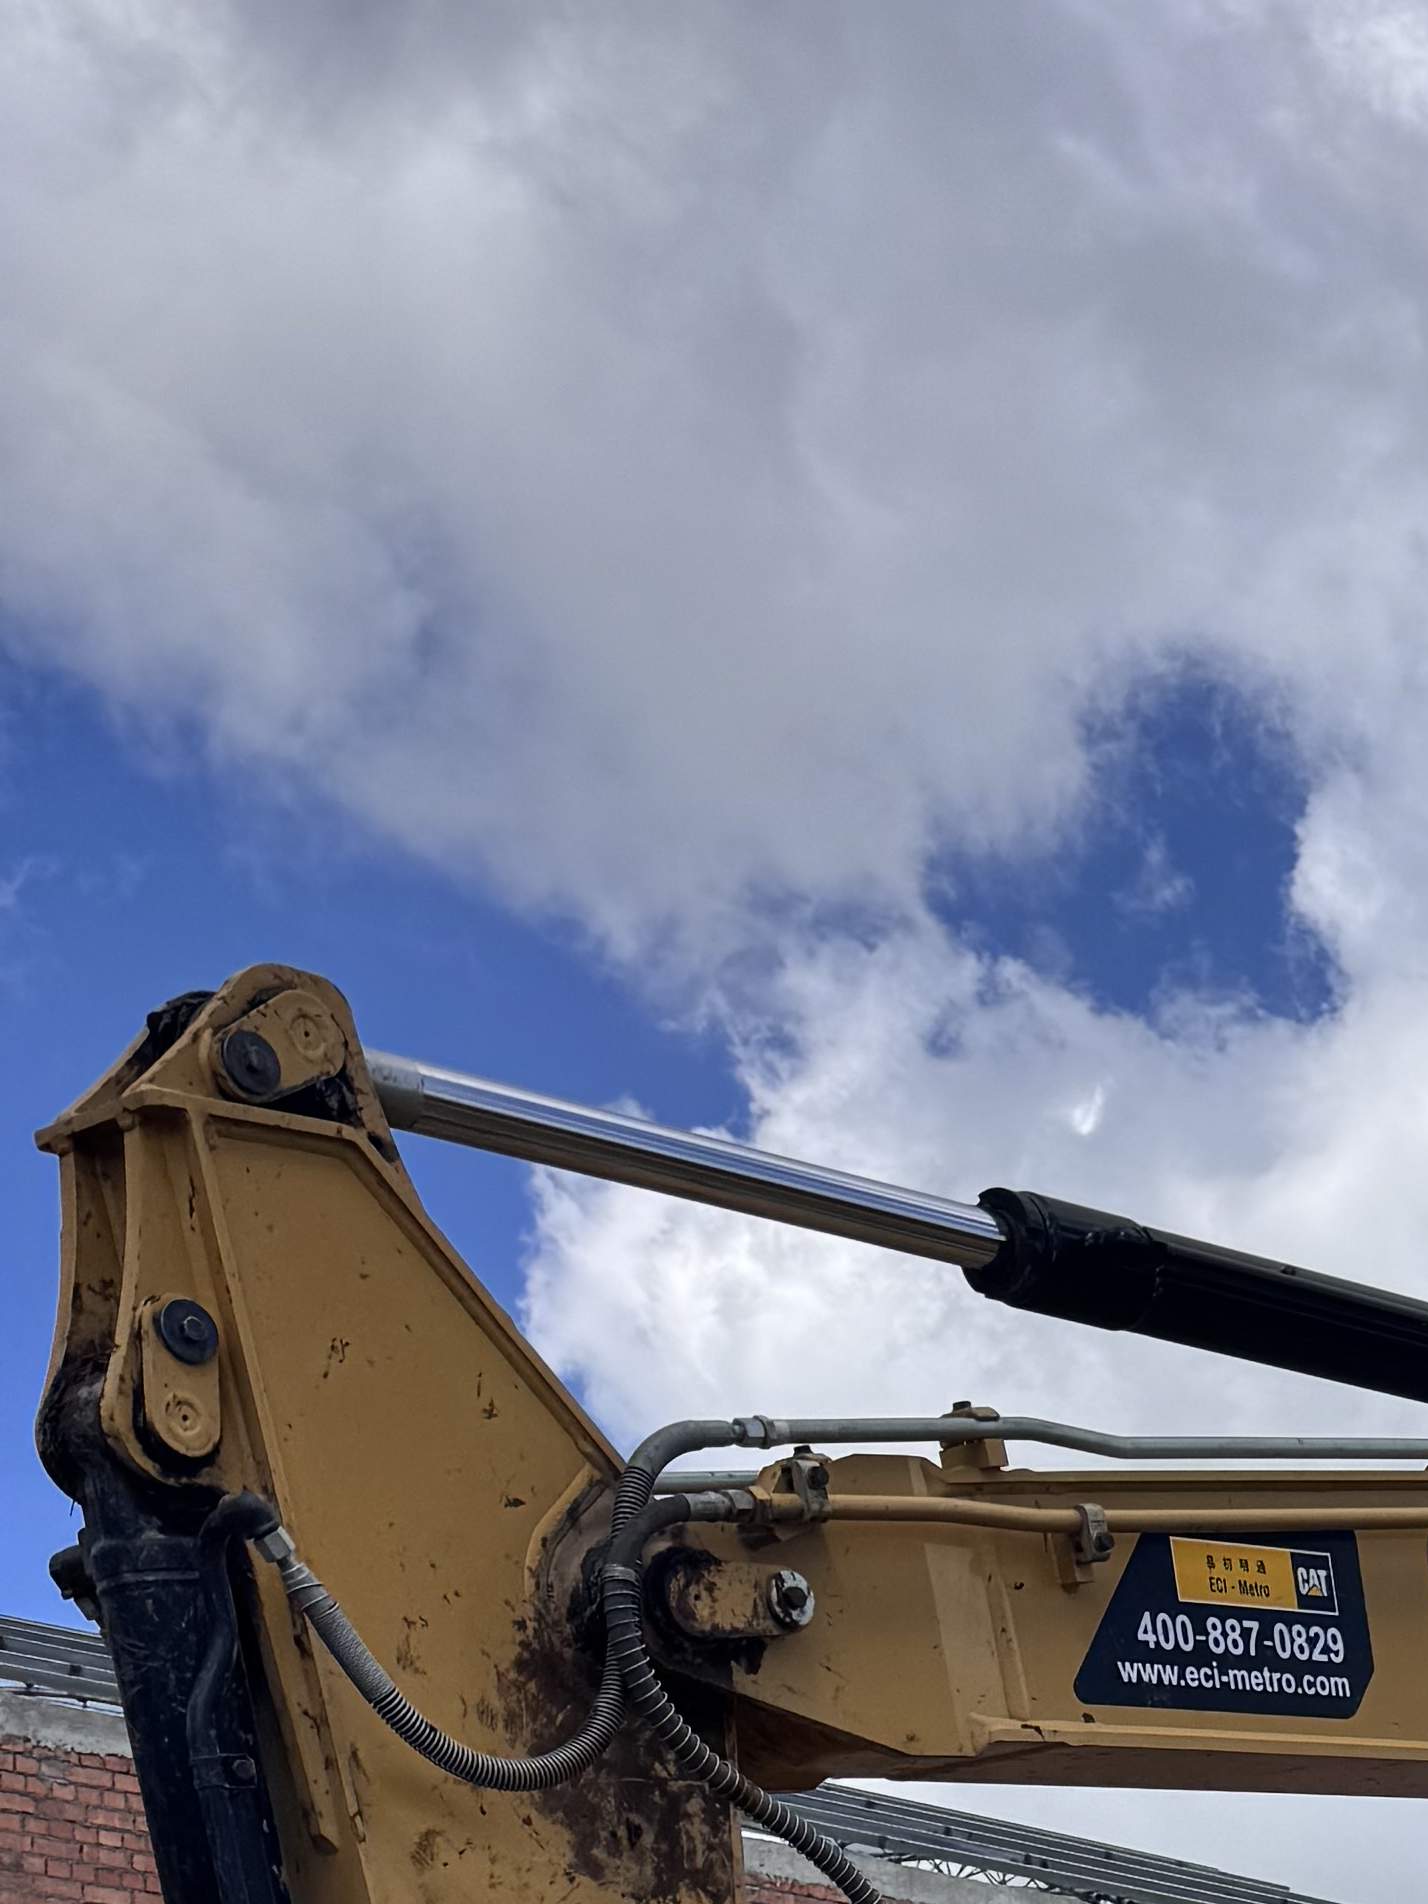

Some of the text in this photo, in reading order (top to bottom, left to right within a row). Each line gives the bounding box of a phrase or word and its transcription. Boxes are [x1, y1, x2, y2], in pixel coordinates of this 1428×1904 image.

[1208, 1576, 1228, 1594] ECI
[1238, 1579, 1270, 1598] Metro
[1297, 1567, 1329, 1597] CAT
[1137, 1611, 1345, 1664] 400-887-0829
[1117, 1661, 1351, 1698] www.eci-metro.com
